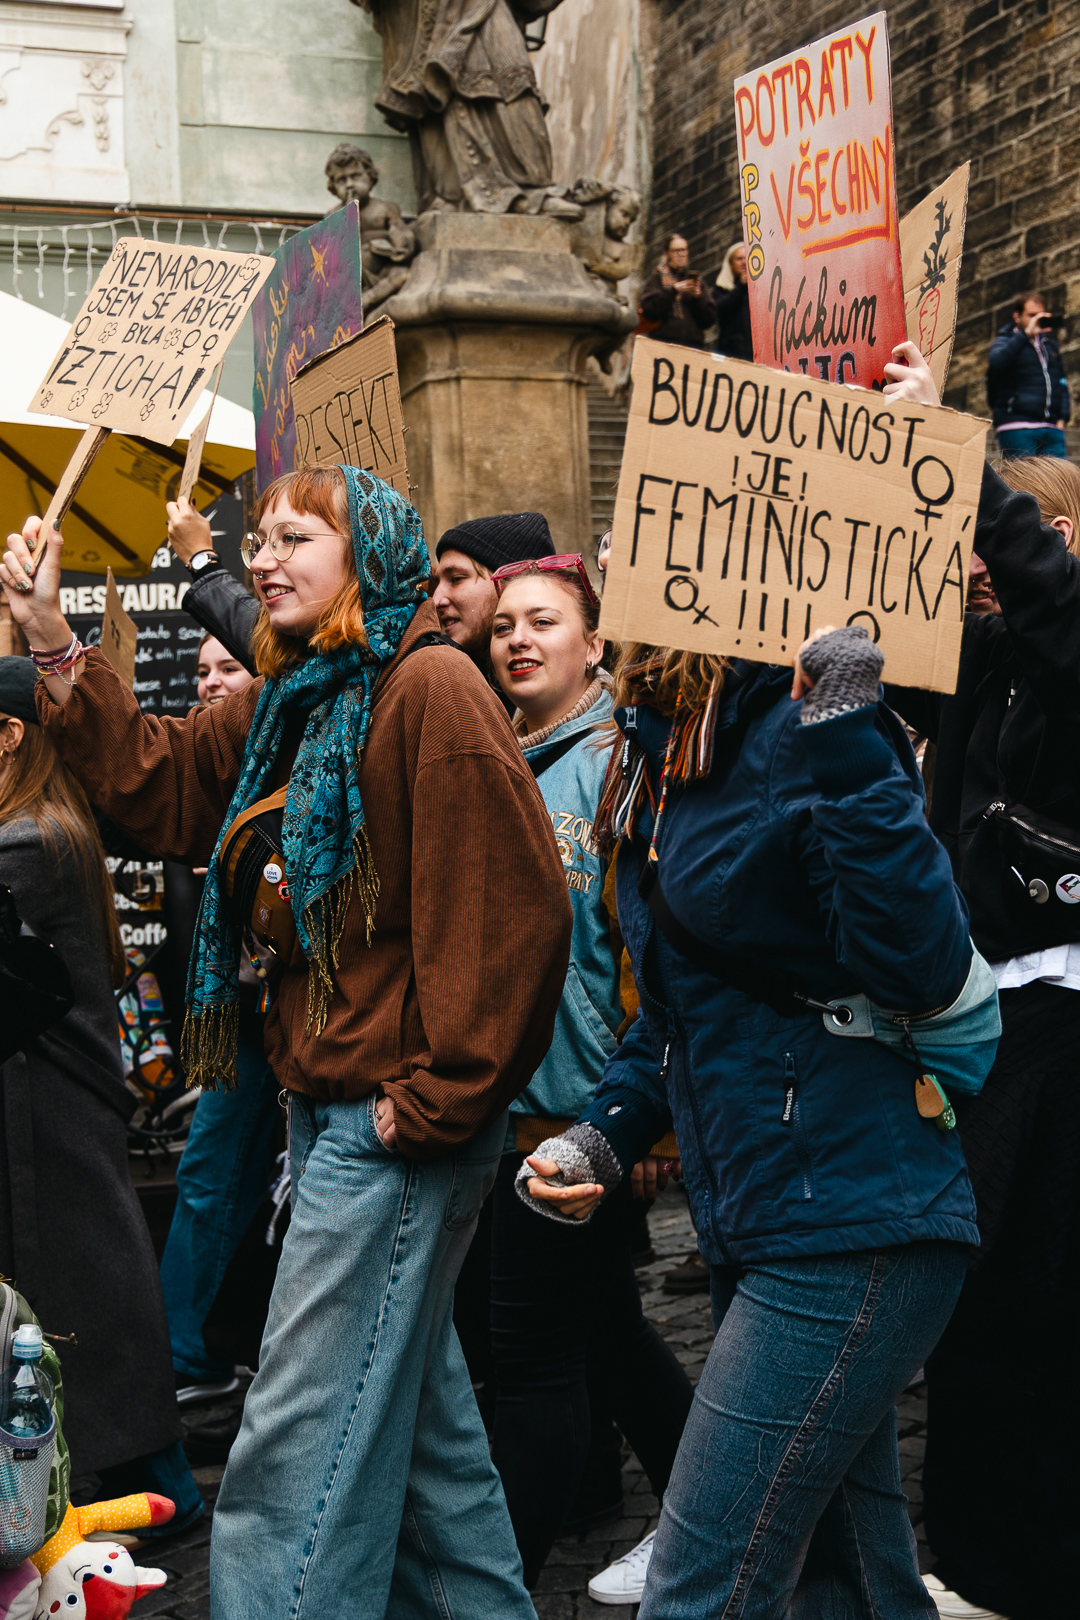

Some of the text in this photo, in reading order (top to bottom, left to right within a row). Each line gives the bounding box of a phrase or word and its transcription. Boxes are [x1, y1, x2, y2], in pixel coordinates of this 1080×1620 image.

[735, 26, 877, 161] POTRATY
[741, 163, 766, 281] PRO
[769, 123, 892, 243] VŠECHNY
[87, 286, 242, 332] JSEM SE ABYCH
[108, 249, 260, 304] NENARODILA
[121, 322, 166, 345] BYLA
[295, 371, 398, 472] RESPEKT
[649, 357, 925, 468] BUDOUCNOST
[630, 473, 972, 623] FEMINISTICKÁ
